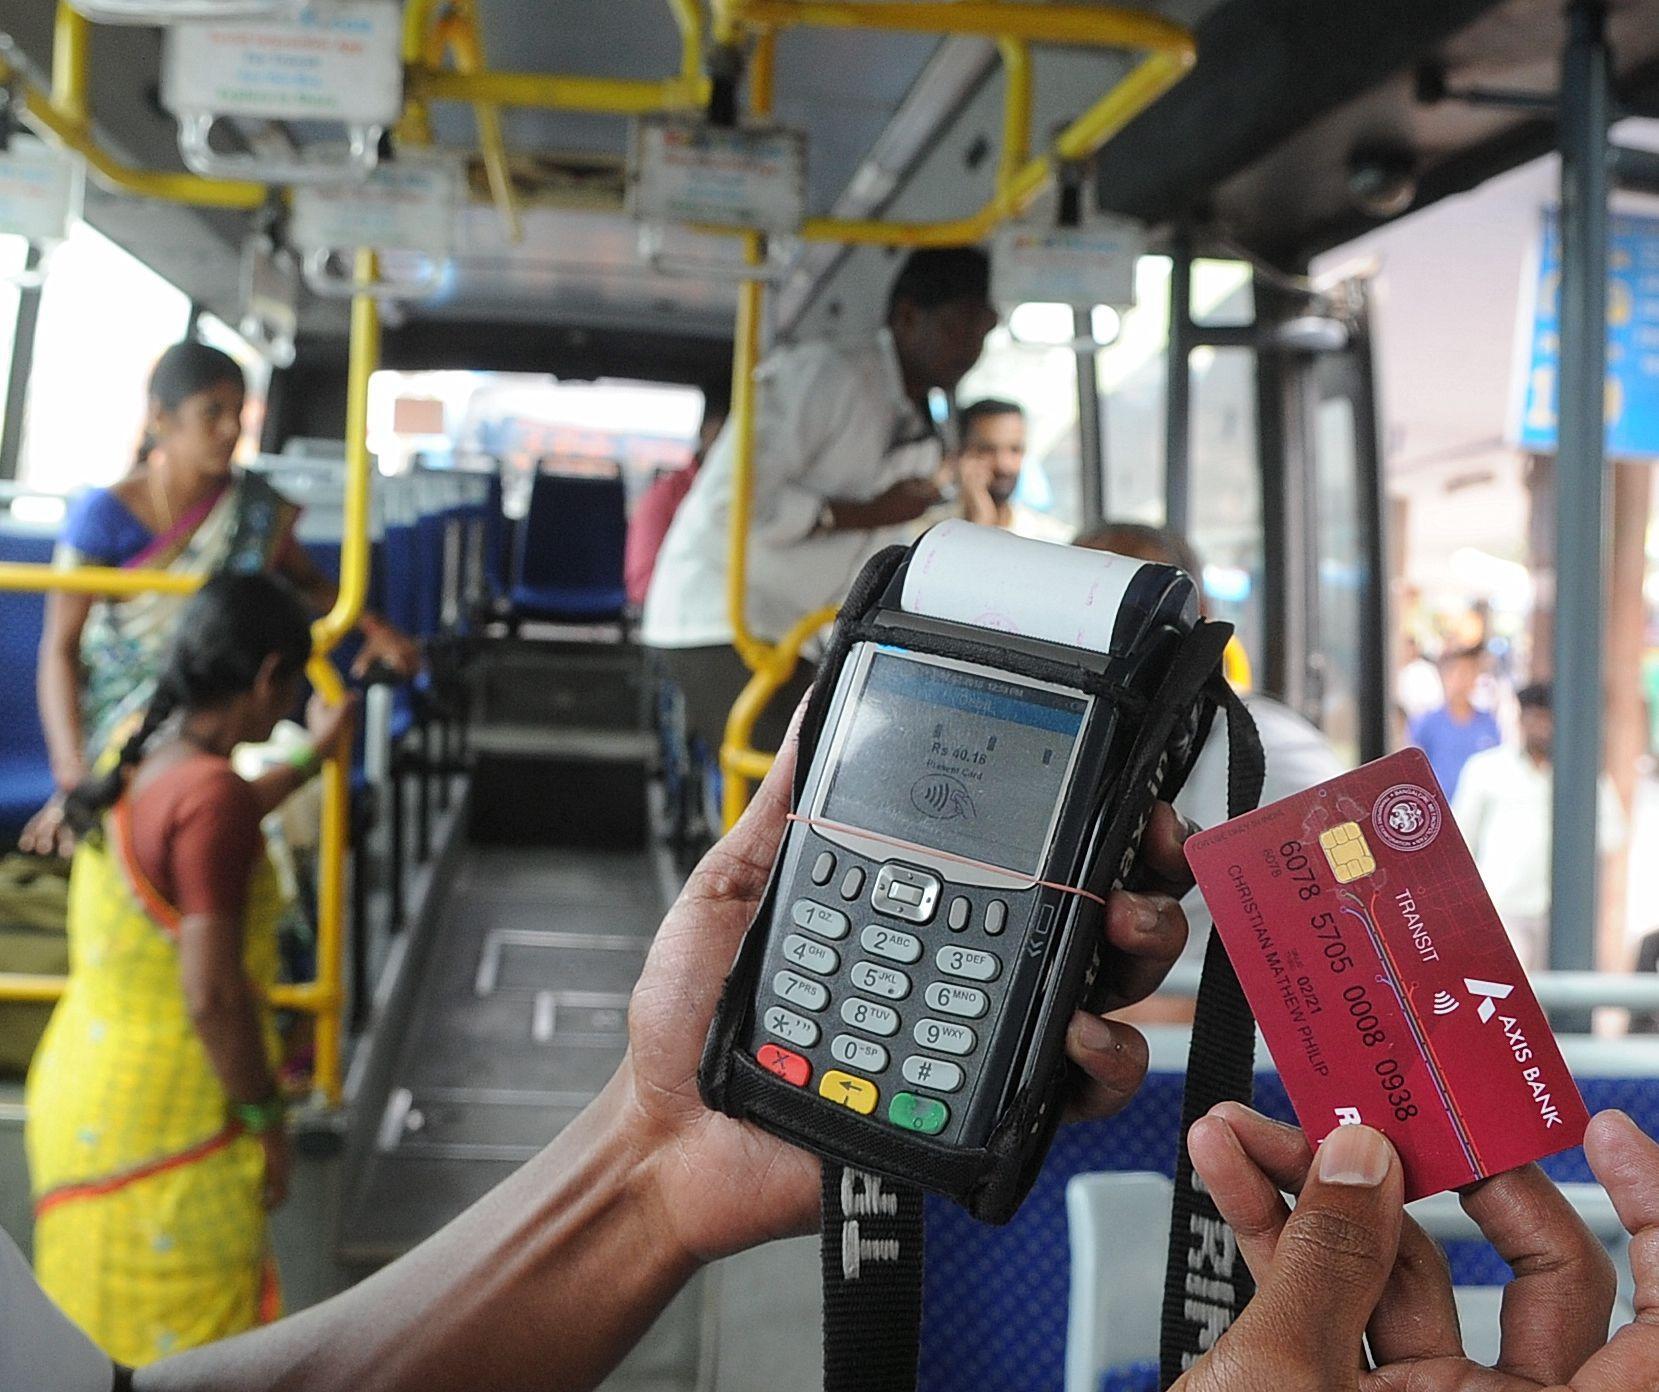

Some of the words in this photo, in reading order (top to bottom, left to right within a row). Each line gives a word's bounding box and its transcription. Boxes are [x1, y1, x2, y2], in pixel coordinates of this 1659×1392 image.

[805, 907, 816, 924] 1
[1395, 888, 1440, 962] TRANSIT
[873, 931, 888, 950] 2
[889, 935, 911, 948] ABC
[793, 943, 807, 960] 4
[808, 945, 826, 960] GHI
[950, 951, 964, 970] 3
[965, 953, 987, 965] DEF
[863, 968, 878, 987] 5
[878, 972, 897, 985] JKL
[1227, 864, 1274, 950] CHRISTIAN
[1265, 951, 1306, 1023] MATHEW
[1297, 1025, 1329, 1077] PHILIP
[784, 977, 799, 995] 7
[798, 982, 818, 996] PRS
[1280, 841, 1321, 901] 6078
[1311, 912, 1354, 974] 5705
[1343, 985, 1386, 1047] 0008
[1375, 1058, 1419, 1122] 0938
[937, 987, 951, 1007] 6
[952, 989, 977, 1002] MNO
[1297, 976, 1322, 1014] 02/21
[854, 1004, 868, 1023] 8
[869, 1007, 890, 1021] TUV
[926, 1024, 940, 1044] 9
[942, 1027, 965, 1040] WXY
[844, 1041, 858, 1060] 0
[1498, 1015, 1533, 1063] AXIS
[1522, 1066, 1563, 1129] BANK
